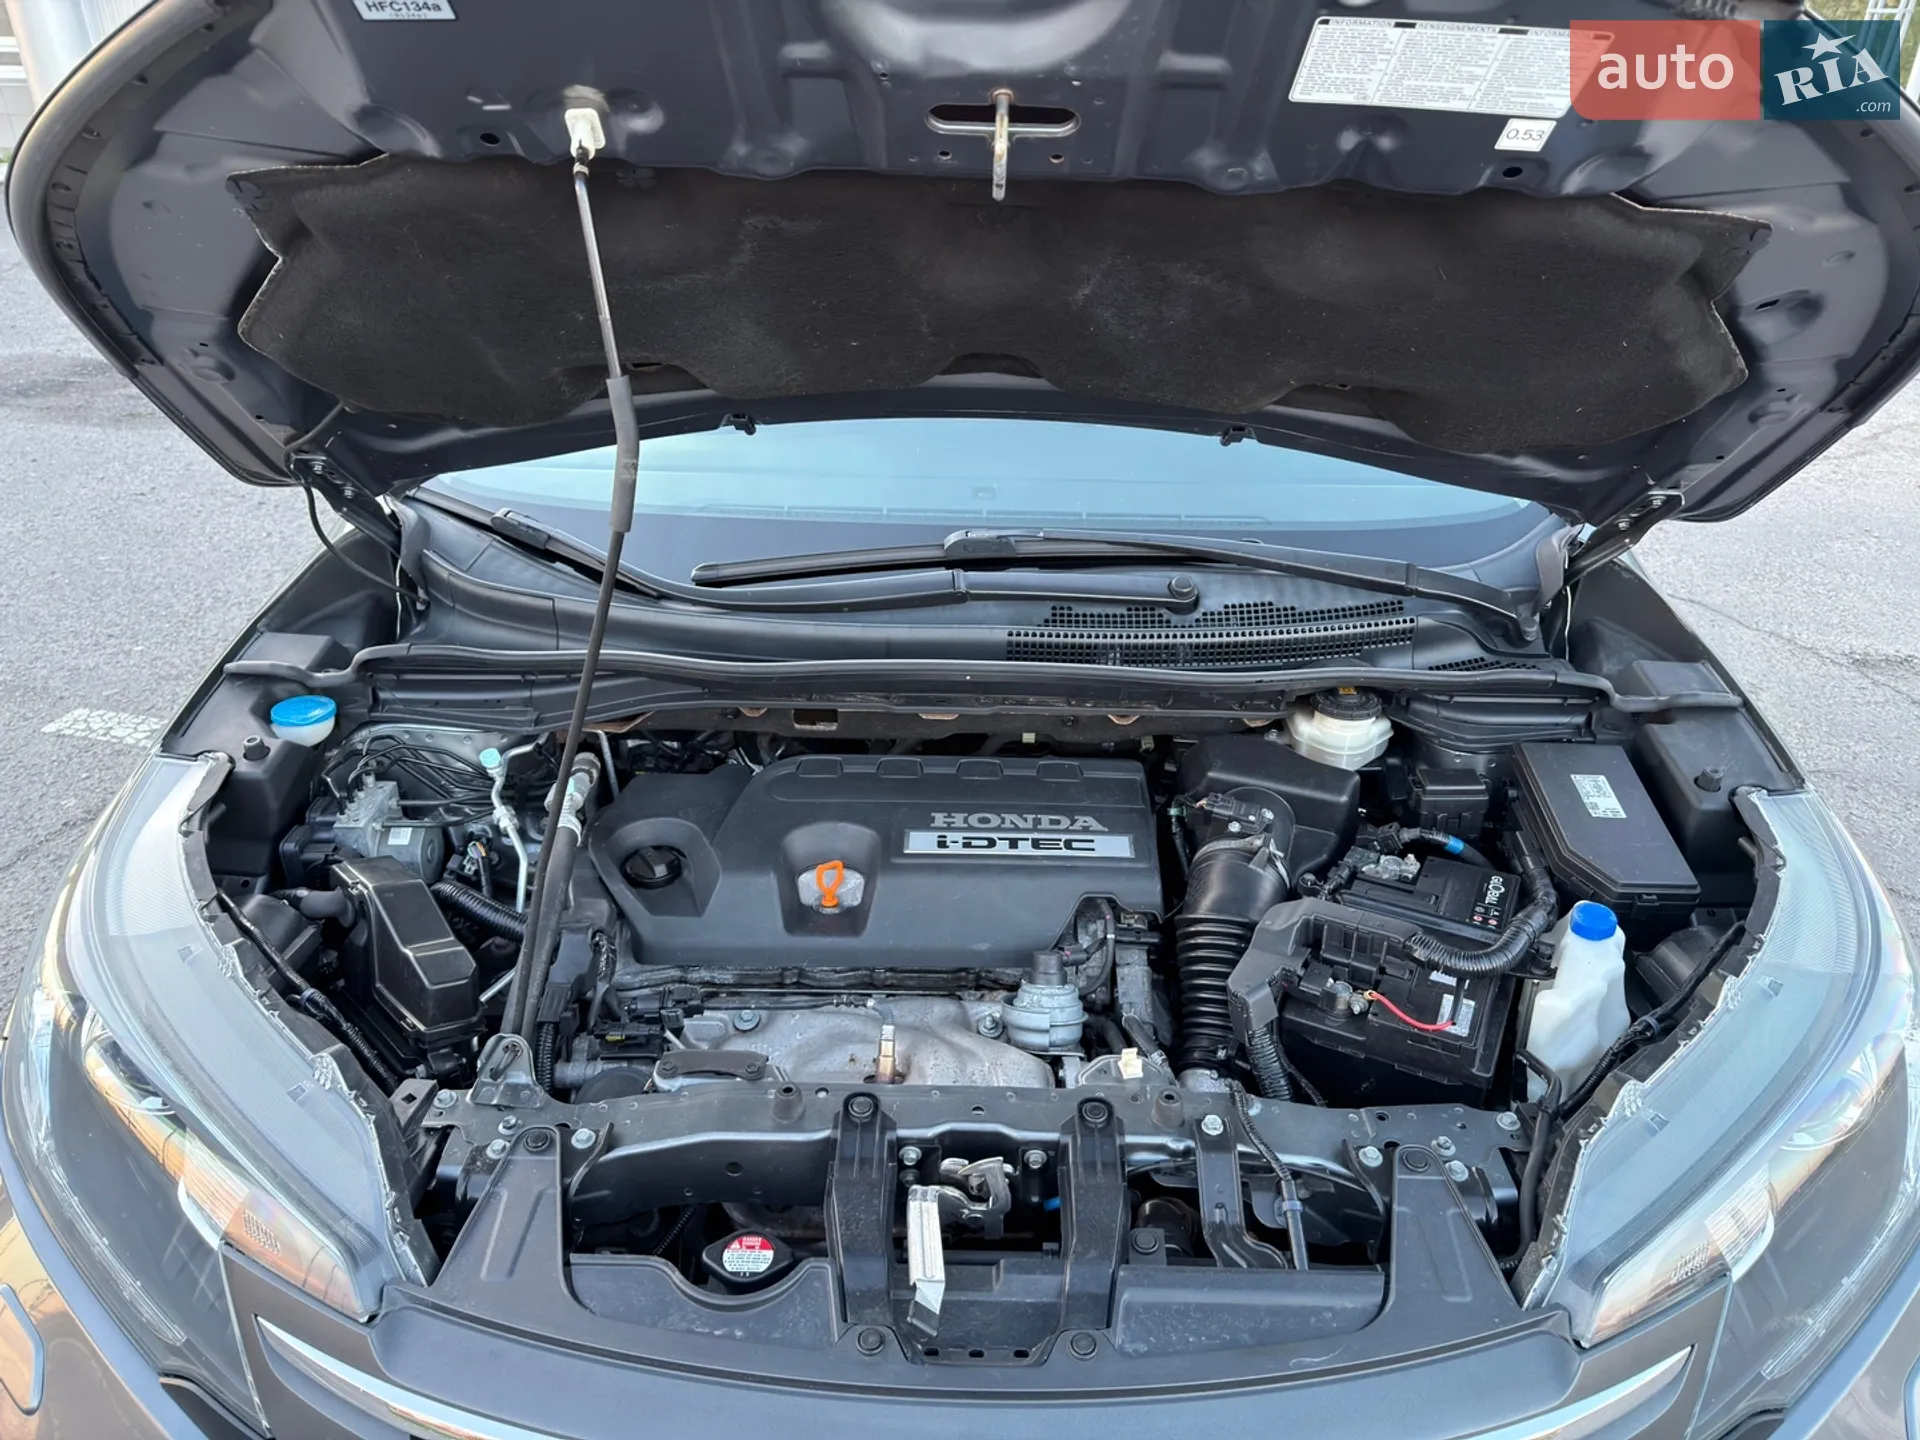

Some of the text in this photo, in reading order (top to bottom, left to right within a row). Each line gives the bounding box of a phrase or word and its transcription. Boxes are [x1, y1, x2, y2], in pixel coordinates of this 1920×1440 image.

[364, 1, 442, 12] HFC134a
[1329, 19, 1392, 28] INFORMATION
[1506, 128, 1545, 141] 0.53
[930, 812, 1109, 832] HONDA
[937, 835, 1096, 851] i-DTEC
[1485, 875, 1505, 904] GLOBAL
